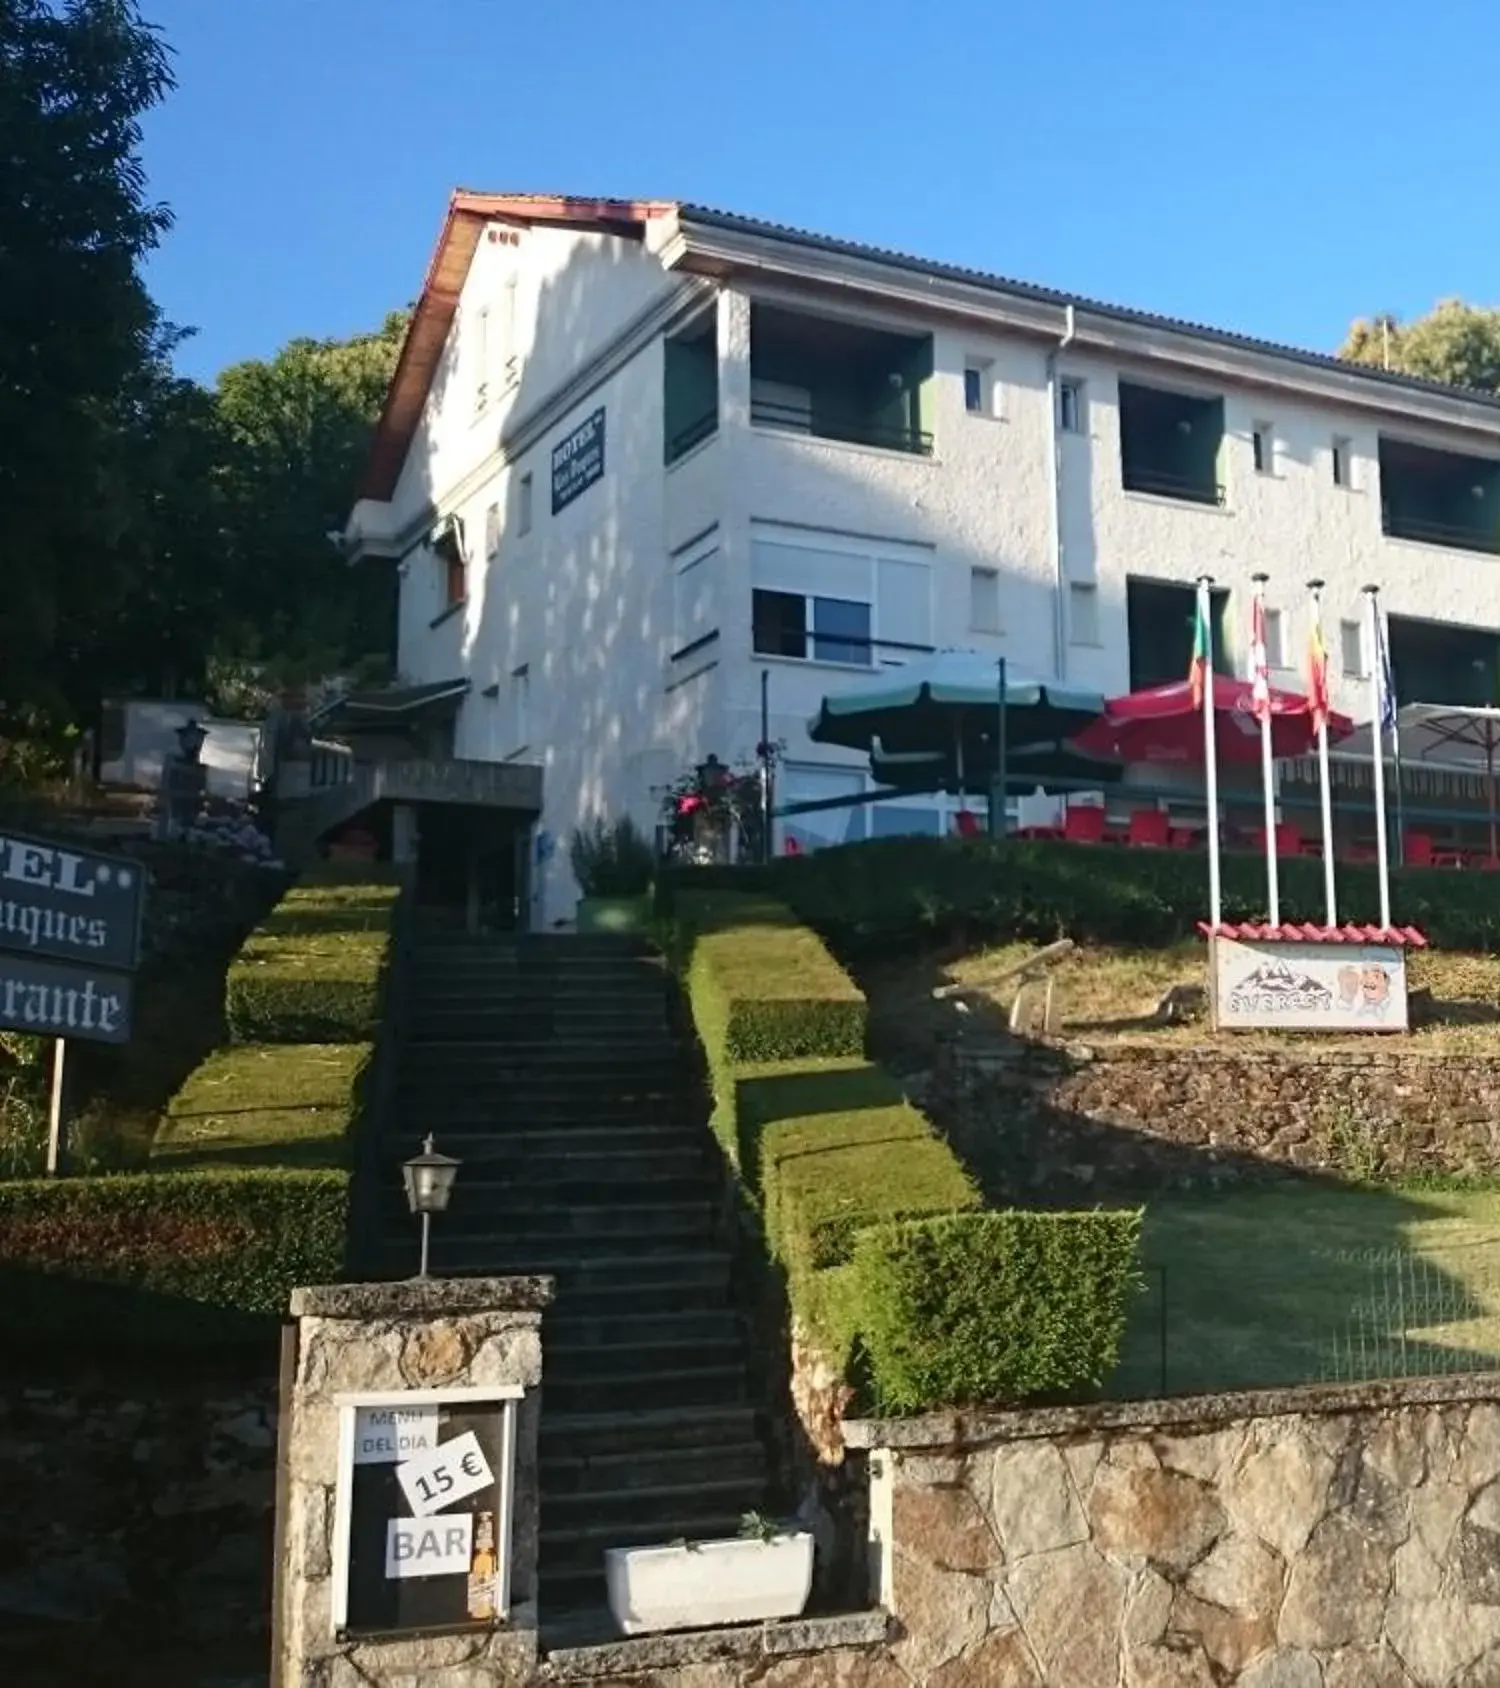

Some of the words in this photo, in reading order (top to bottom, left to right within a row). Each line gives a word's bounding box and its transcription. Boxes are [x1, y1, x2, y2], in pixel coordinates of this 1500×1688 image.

[0, 837, 95, 897] EL
[0, 978, 122, 1032] rante
[370, 1409, 424, 1428] MENU
[363, 1436, 396, 1453] DEL
[415, 1465, 455, 1504] 15
[460, 1450, 483, 1477] €
[394, 1528, 466, 1562] BAR
